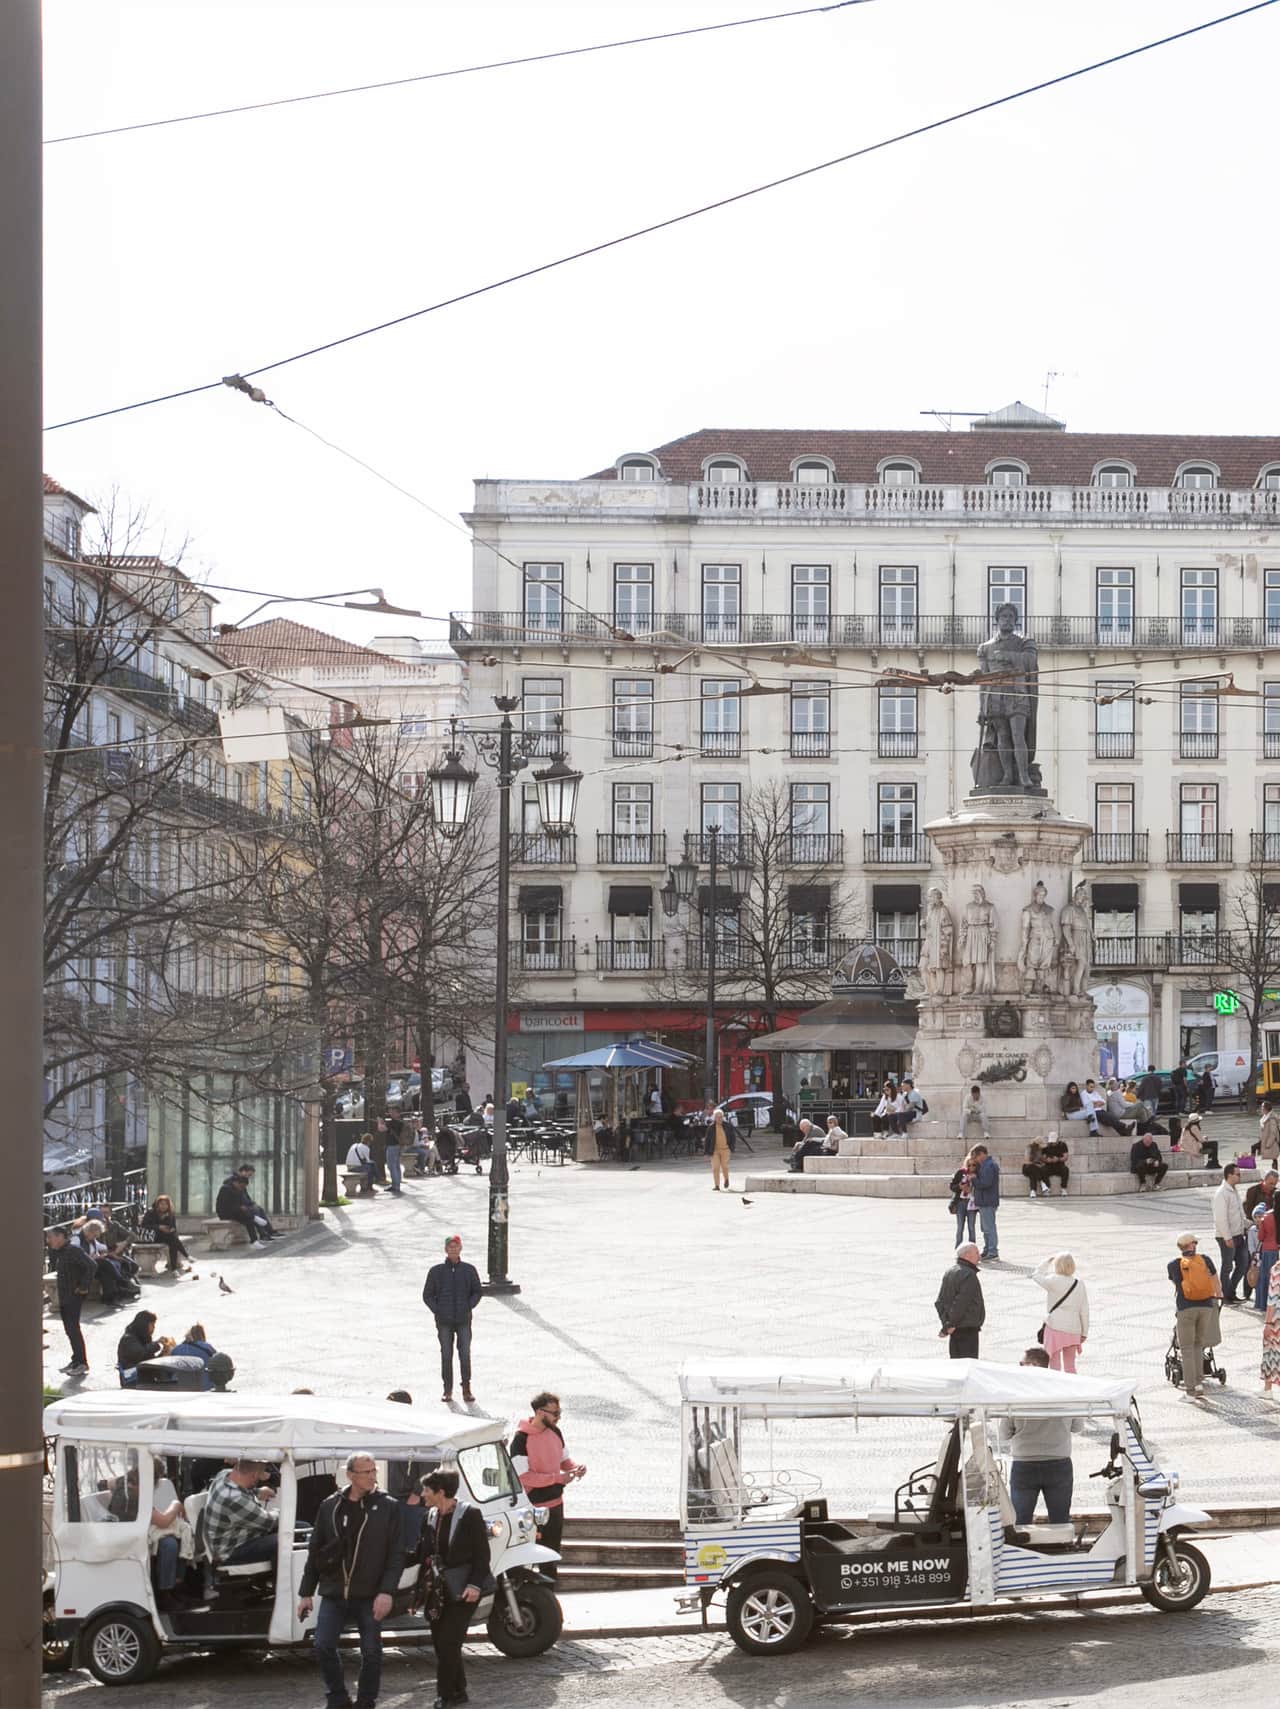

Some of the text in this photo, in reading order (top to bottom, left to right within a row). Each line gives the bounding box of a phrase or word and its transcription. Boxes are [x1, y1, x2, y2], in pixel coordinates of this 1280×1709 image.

[331, 1048, 344, 1066] P
[841, 1558, 950, 1575] BOOK ME NOW
[854, 1572, 951, 1587] +351 918 348 899
